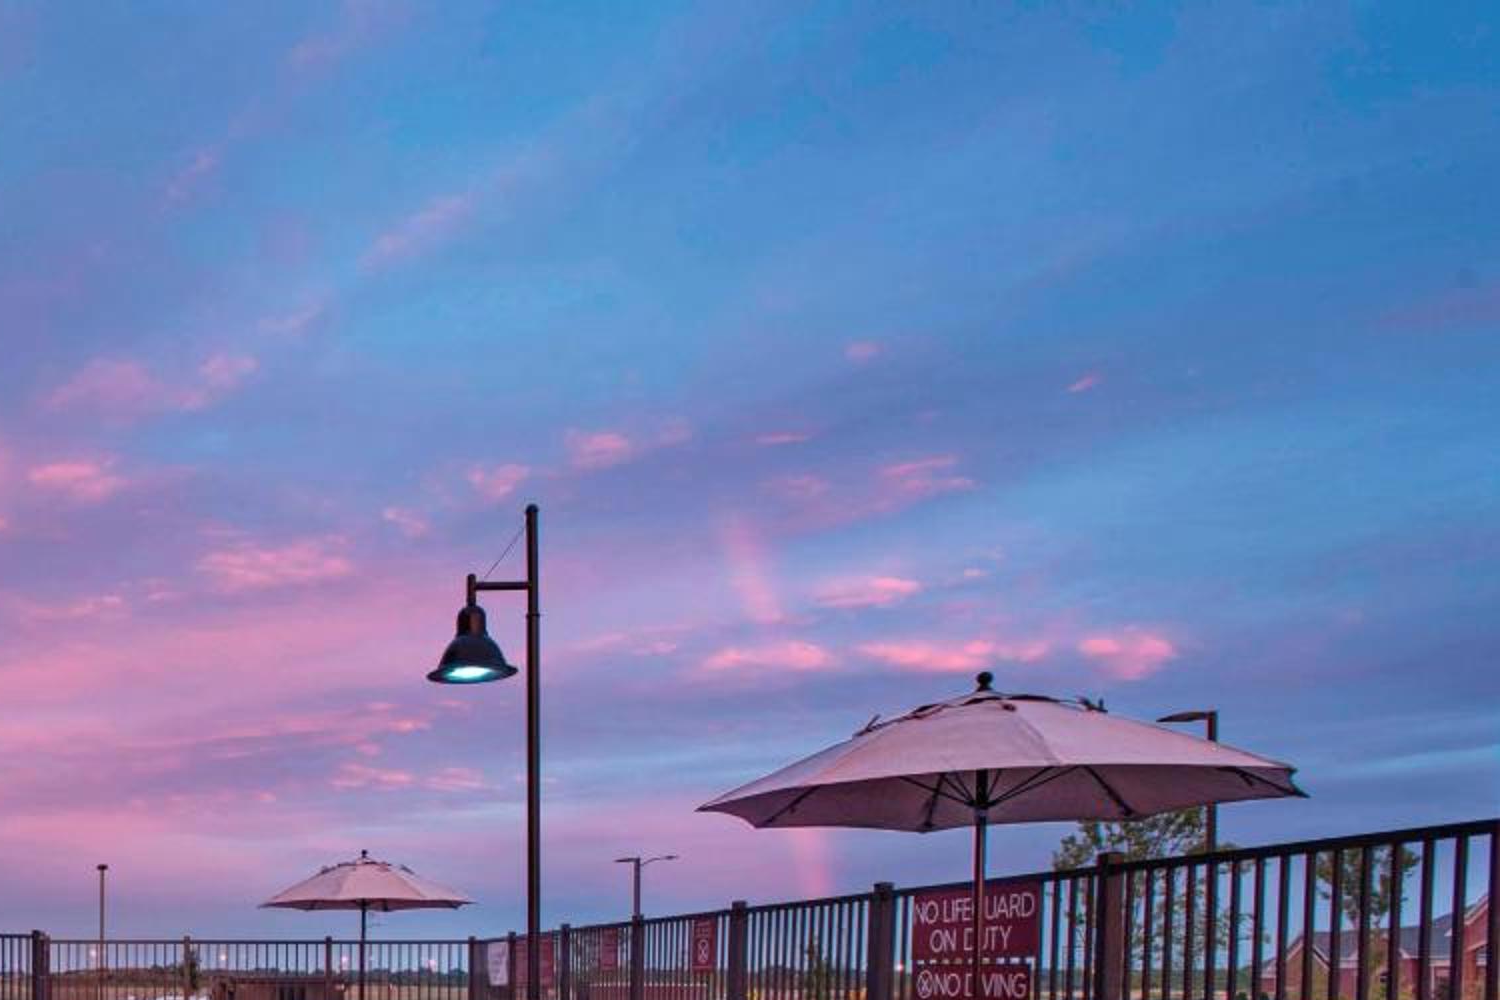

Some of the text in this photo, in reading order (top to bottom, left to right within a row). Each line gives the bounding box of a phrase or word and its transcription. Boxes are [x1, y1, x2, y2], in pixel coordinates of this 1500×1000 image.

[914, 892, 1034, 924] NO LIFEUARD
[930, 928, 957, 952] ON
[933, 973, 1027, 998] NO DVING
